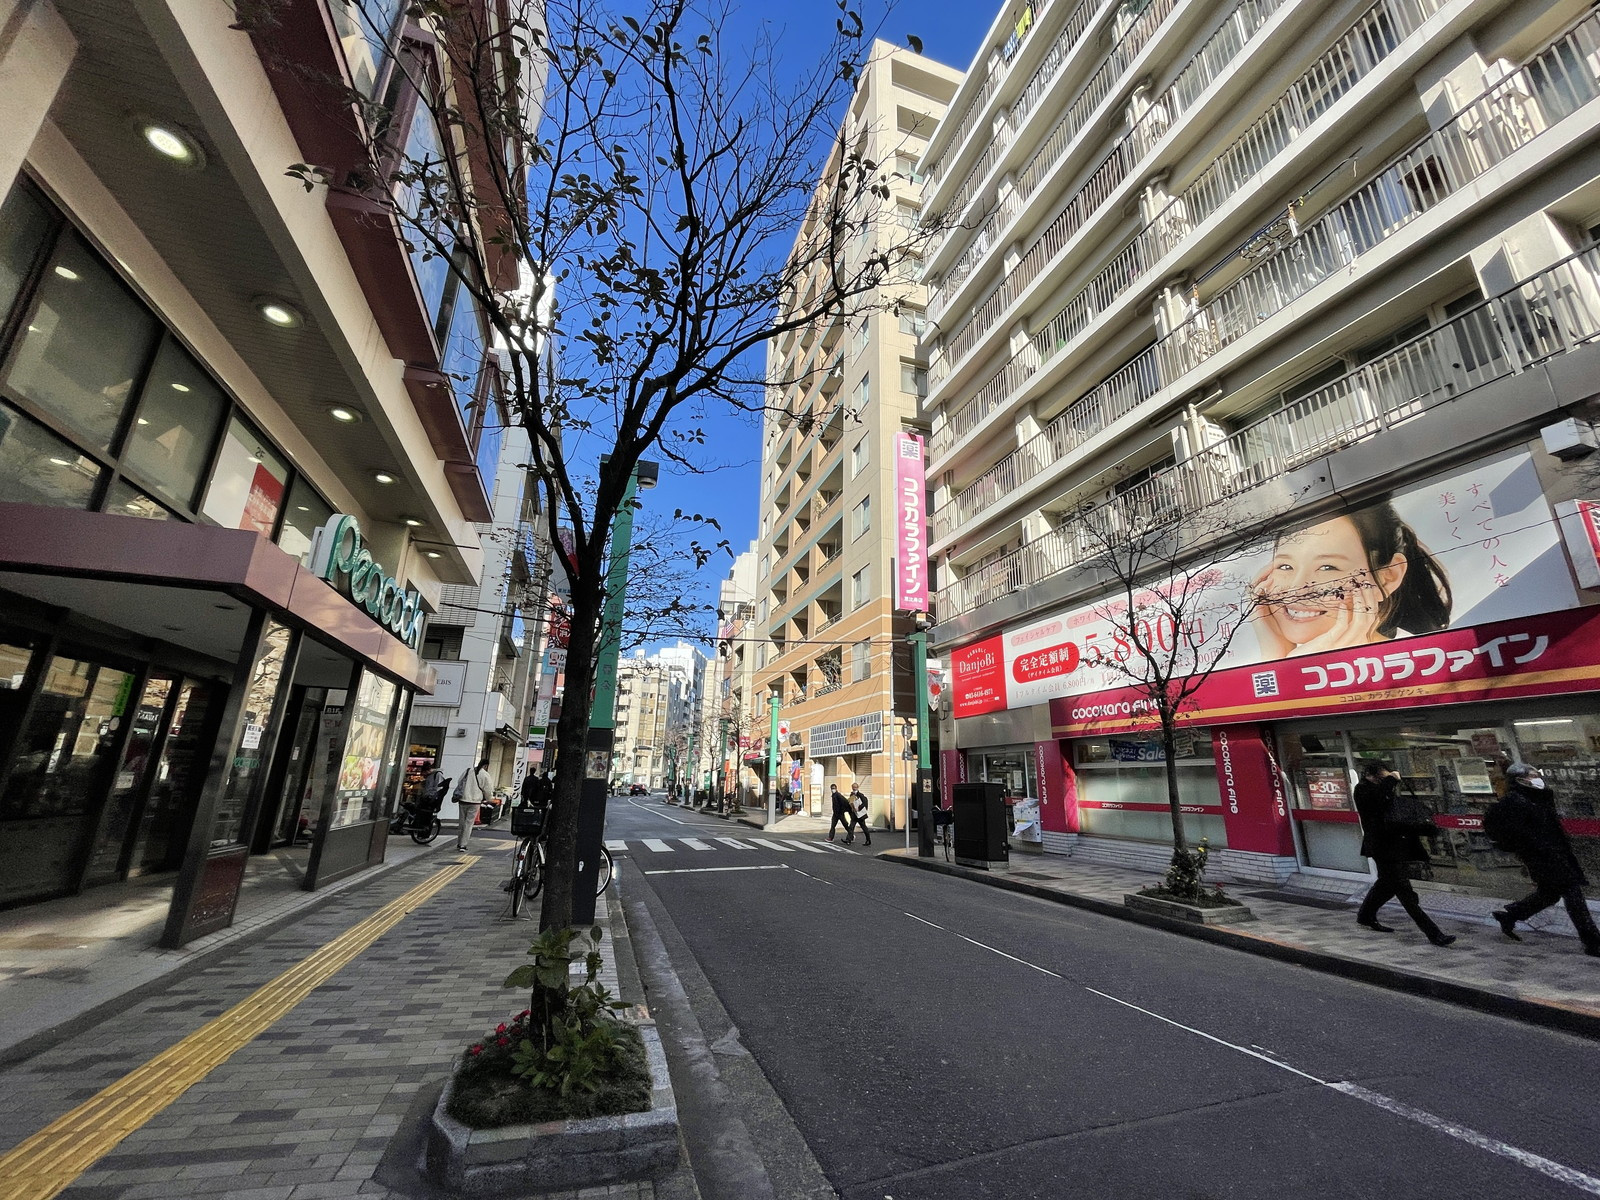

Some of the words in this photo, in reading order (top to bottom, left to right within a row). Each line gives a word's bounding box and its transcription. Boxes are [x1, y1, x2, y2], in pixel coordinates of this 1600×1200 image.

[903, 441, 918, 458] 薬
[904, 477, 921, 594] ココカラファイン
[1439, 492, 1461, 540] 美しく
[1466, 483, 1509, 587] すべての人を
[315, 514, 424, 654] Peacock
[959, 652, 995, 673] DanjoBi
[1020, 647, 1069, 672] 完全定額制
[1301, 634, 1549, 690] ココカラファイン
[1254, 673, 1277, 696] 薬
[1072, 702, 1130, 719] cocokara
[1039, 745, 1047, 785] cocokara
[1137, 748, 1165, 761] Sale
[1219, 731, 1235, 786] cocokara
[1227, 787, 1238, 814] fine
[512, 760, 524, 800] クリーニング
[1275, 788, 1285, 816] fine
